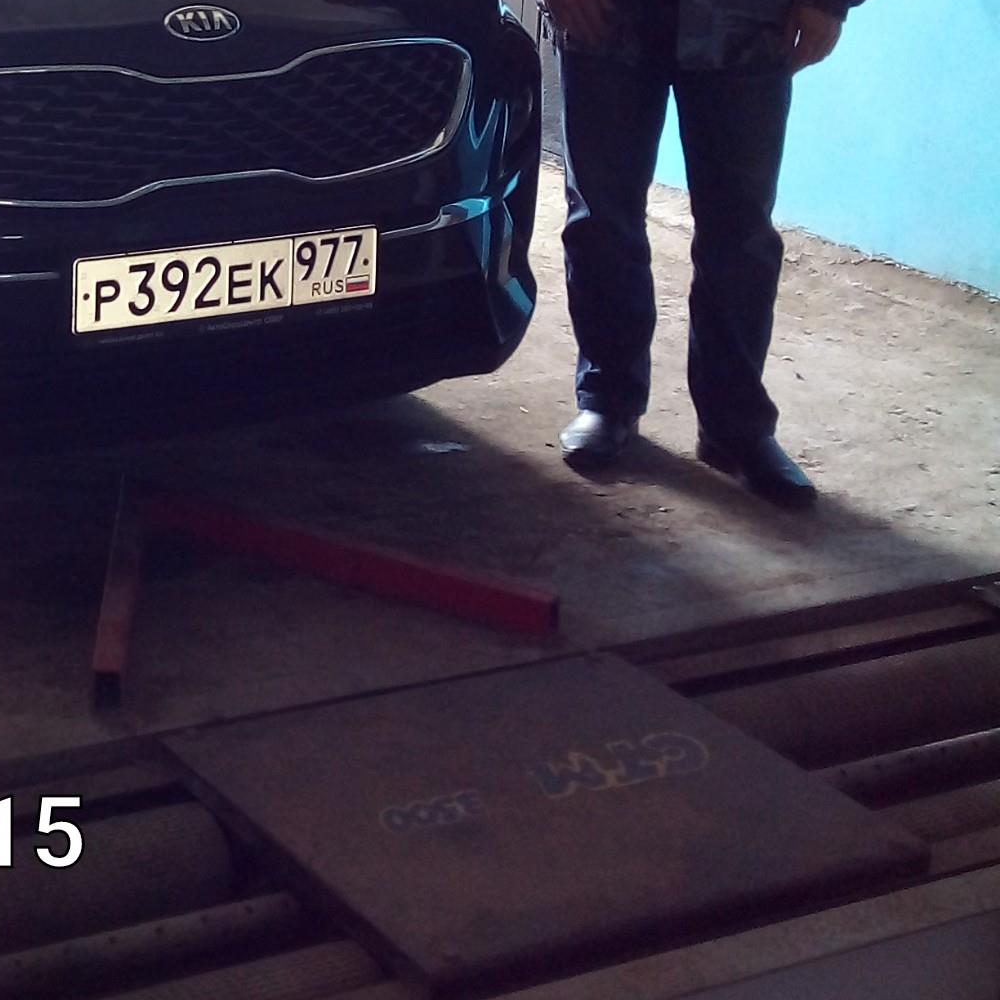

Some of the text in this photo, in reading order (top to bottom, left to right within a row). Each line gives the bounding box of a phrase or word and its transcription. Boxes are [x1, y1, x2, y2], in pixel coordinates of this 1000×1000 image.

[175, 10, 233, 34] KIA
[94, 235, 363, 322] Р392ЕК 977
[311, 278, 344, 297] RUS
